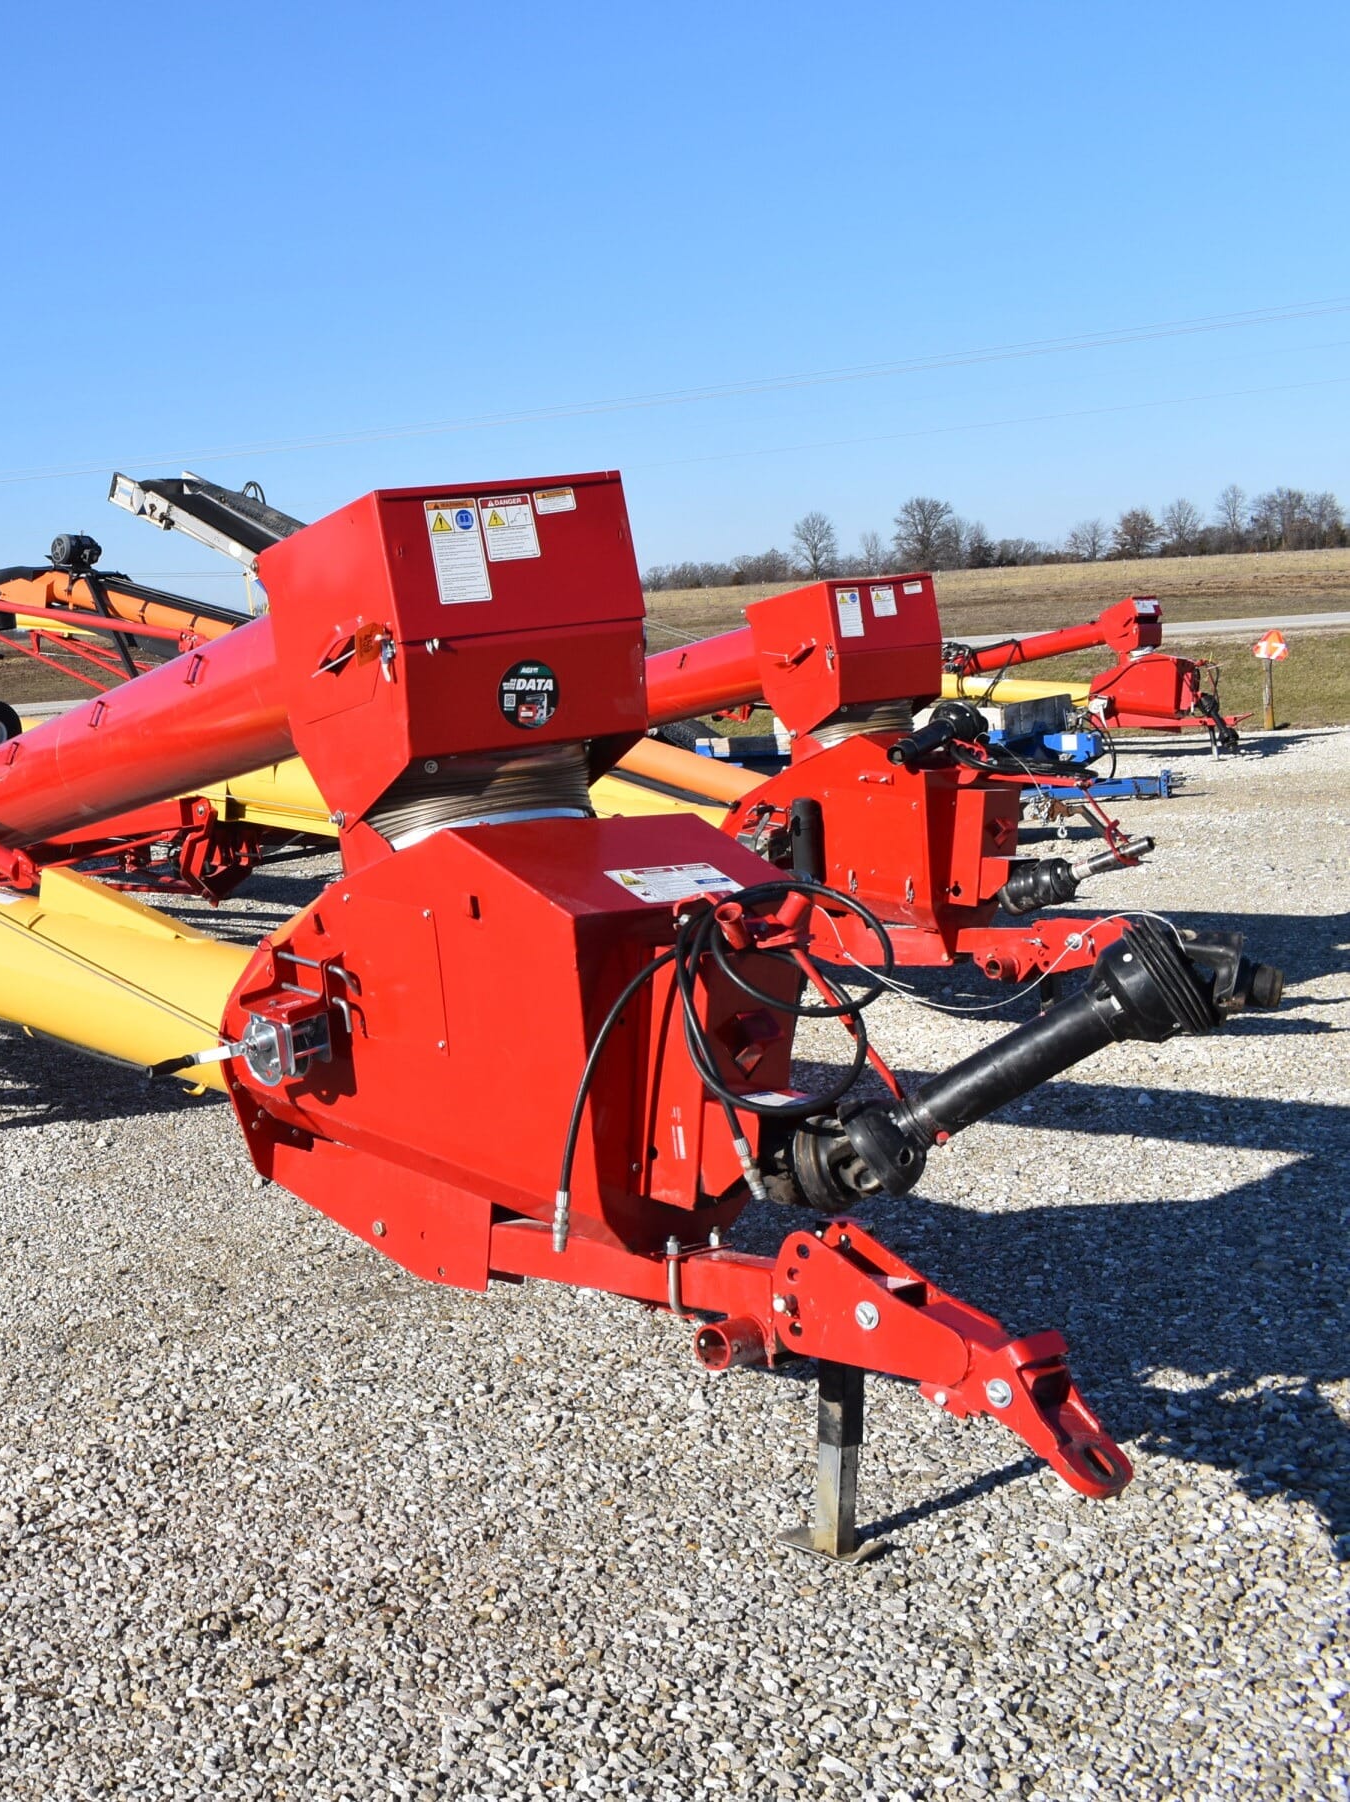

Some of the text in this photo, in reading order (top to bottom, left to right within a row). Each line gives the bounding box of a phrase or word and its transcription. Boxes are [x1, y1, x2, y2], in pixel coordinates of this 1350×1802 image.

[494, 497, 522, 506] DANGER
[1255, 641, 1286, 660] 17
[515, 678, 554, 691] DATA
